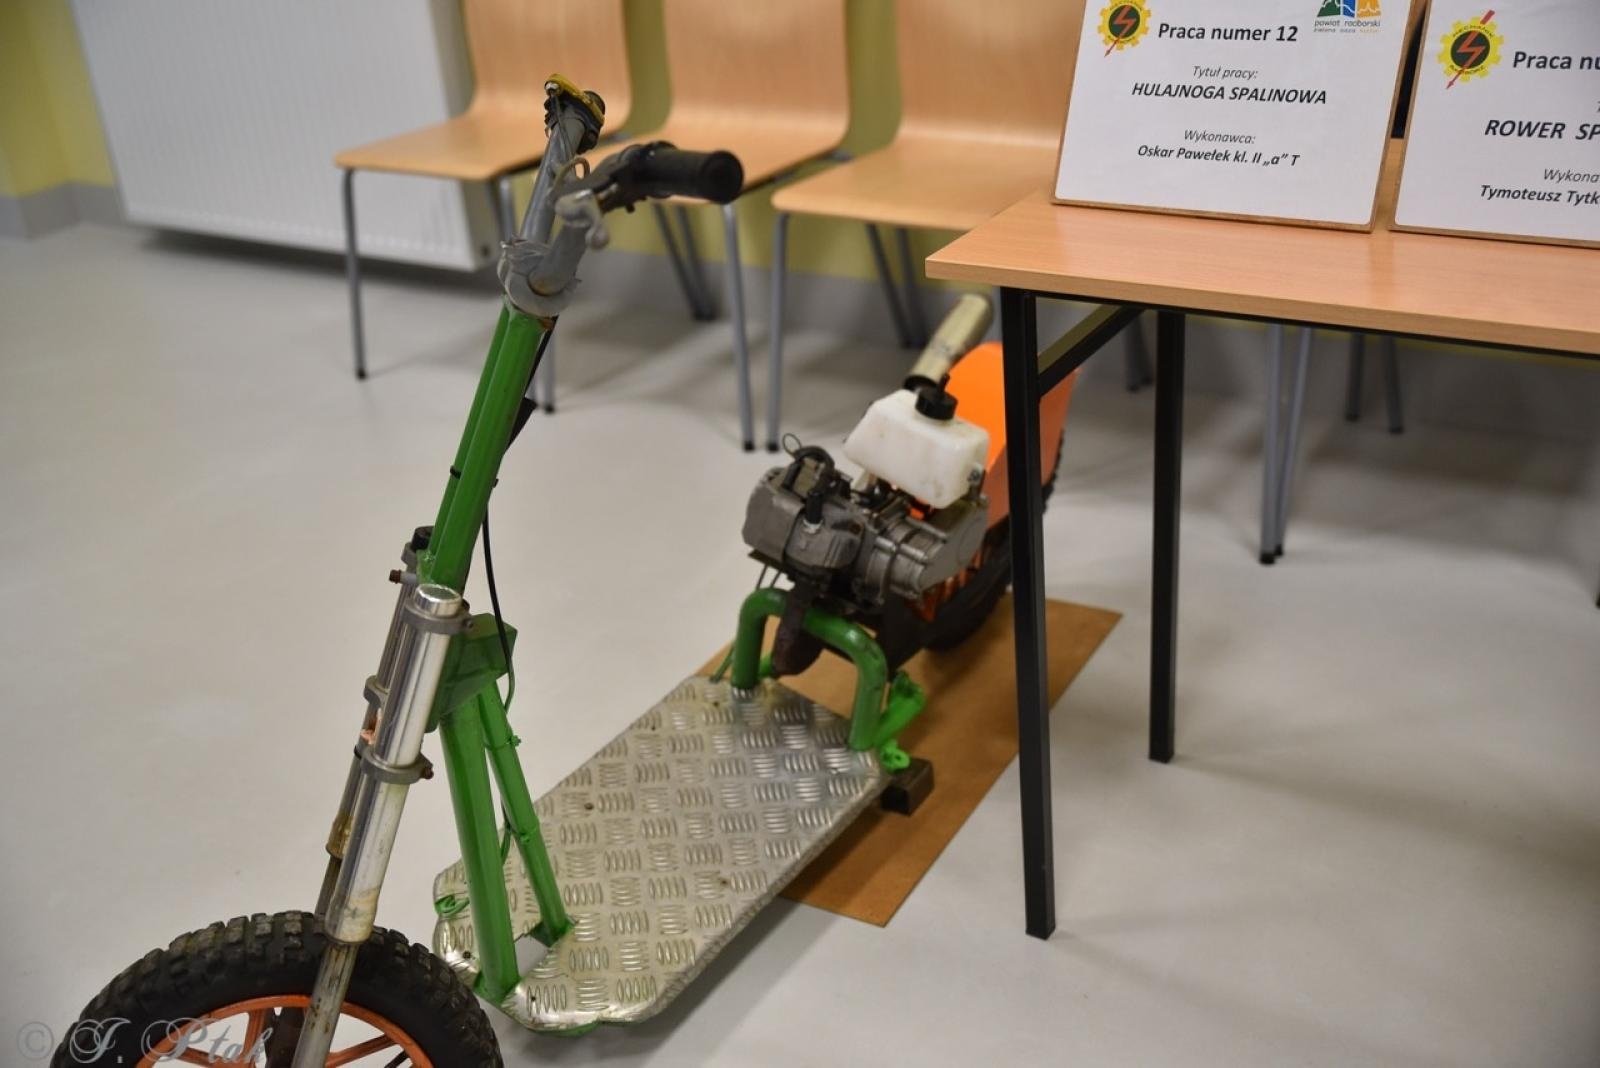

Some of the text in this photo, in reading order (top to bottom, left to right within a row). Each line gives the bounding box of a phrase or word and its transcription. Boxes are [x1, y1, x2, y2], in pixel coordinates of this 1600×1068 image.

[1158, 22, 1299, 42] Praca numer 12
[1513, 51, 1573, 70] Praca
[1193, 65, 1259, 80] Tytuł pracy:
[1131, 82, 1327, 104] HULAJNOGA SPALINOWA
[1184, 129, 1256, 145] Wykonawca:
[1484, 119, 1567, 139] ROWER
[1137, 145, 1175, 159] Oskar
[1176, 147, 1231, 163] Pawełek
[1232, 149, 1248, 163] kl.
[1290, 154, 1301, 167] T
[1481, 184, 1562, 202] Tymoteusz
